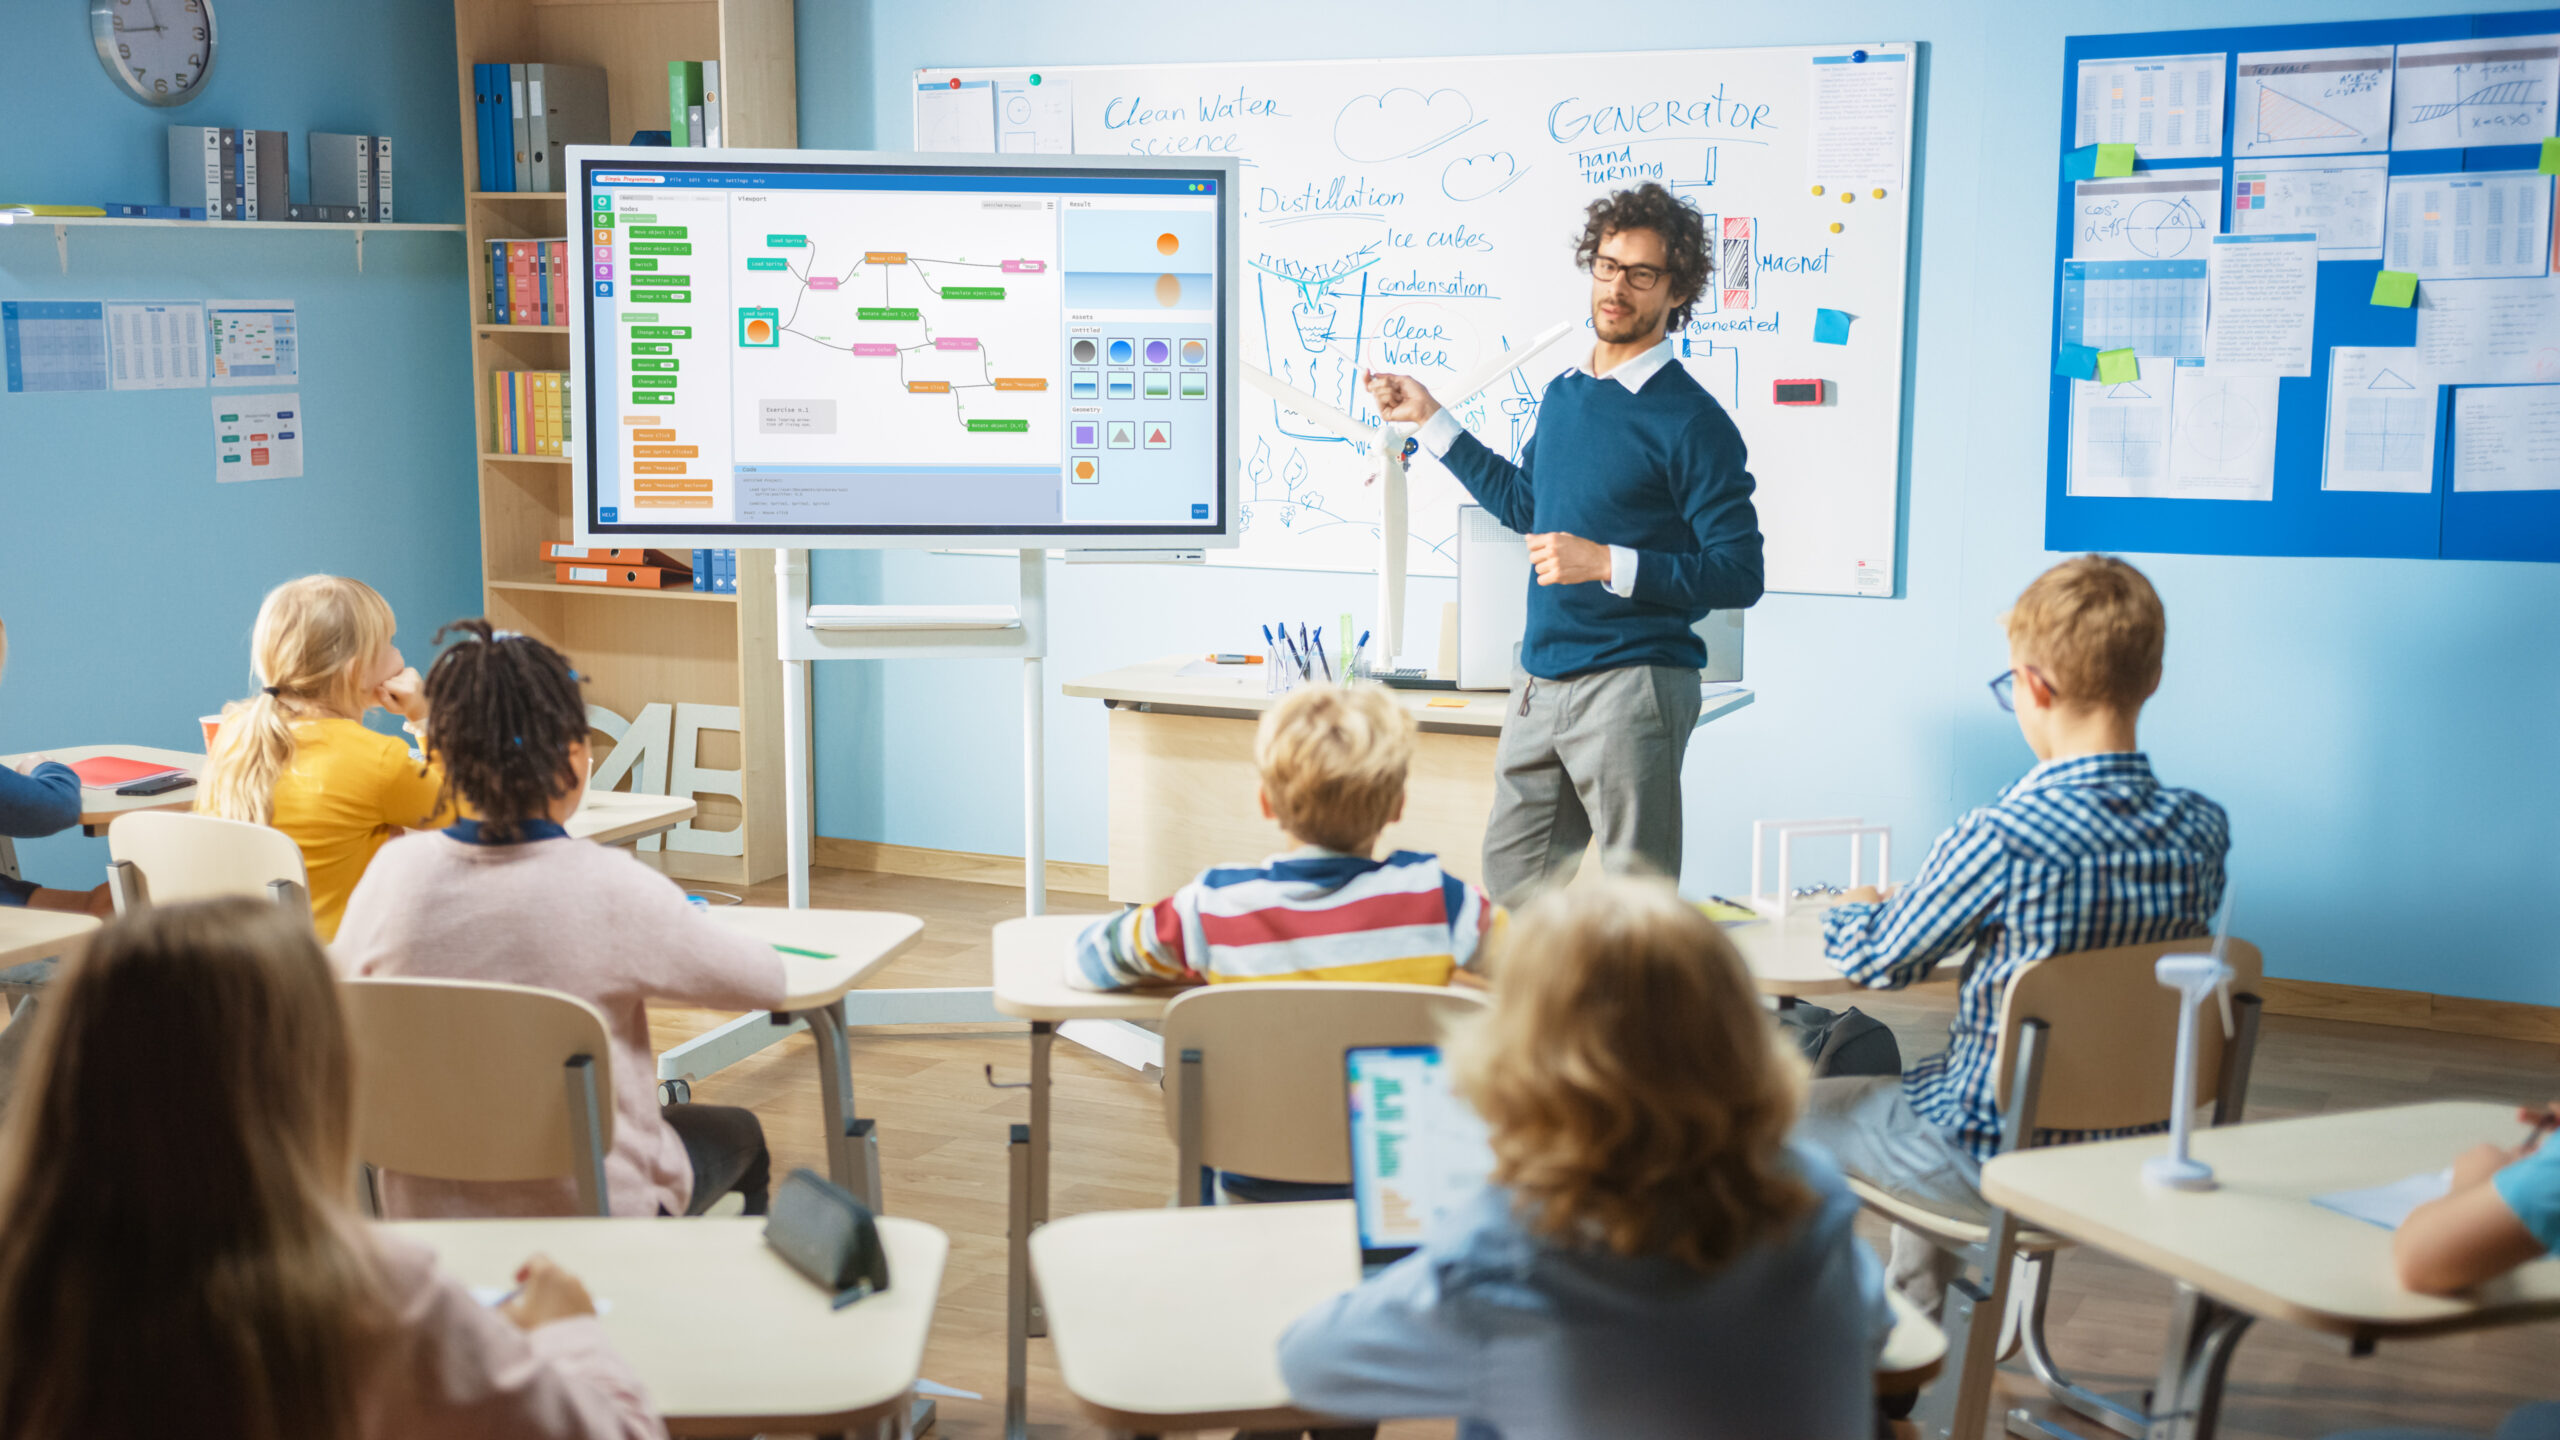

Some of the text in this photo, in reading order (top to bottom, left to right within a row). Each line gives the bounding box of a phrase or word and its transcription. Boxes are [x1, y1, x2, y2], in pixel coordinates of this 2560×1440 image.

[192, 27, 205, 41] 3
[188, 53, 201, 69] 4
[133, 67, 146, 82] 7
[175, 73, 188, 88] 5
[154, 78, 168, 94] 6
[1105, 86, 1291, 129] Clean Water
[1128, 134, 1243, 156] science
[1579, 145, 1632, 168] hand
[622, 176, 656, 184] Programming
[1258, 176, 1404, 212] Distillation
[1387, 224, 1494, 252] Ice cubes
[1762, 247, 1835, 274] Magnet
[1690, 311, 1779, 335] generated
